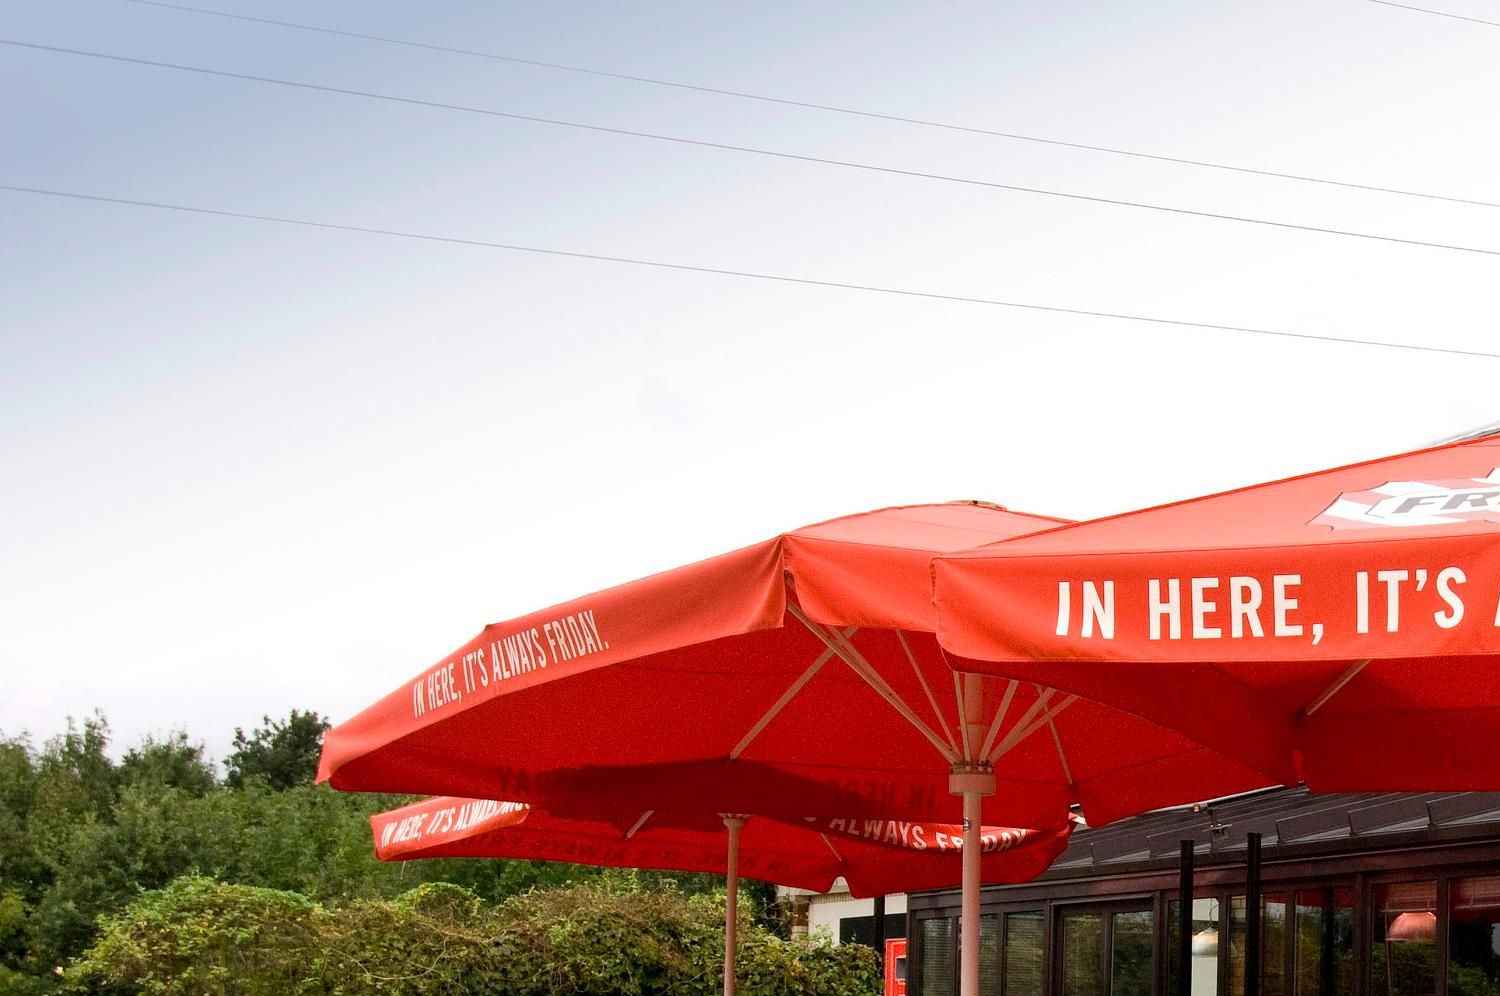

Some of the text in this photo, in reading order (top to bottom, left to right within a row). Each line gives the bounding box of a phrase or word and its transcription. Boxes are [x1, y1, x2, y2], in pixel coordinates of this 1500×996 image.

[1055, 580, 1115, 640] IN
[1148, 574, 1324, 645] HERE,
[1356, 566, 1467, 634] IT'S
[412, 608, 610, 719] IN HERE, IT'S ALWAYS FRIDAY.
[381, 821, 398, 848] IN
[425, 807, 456, 835] IT'S
[935, 828, 1027, 852] FRDAY
